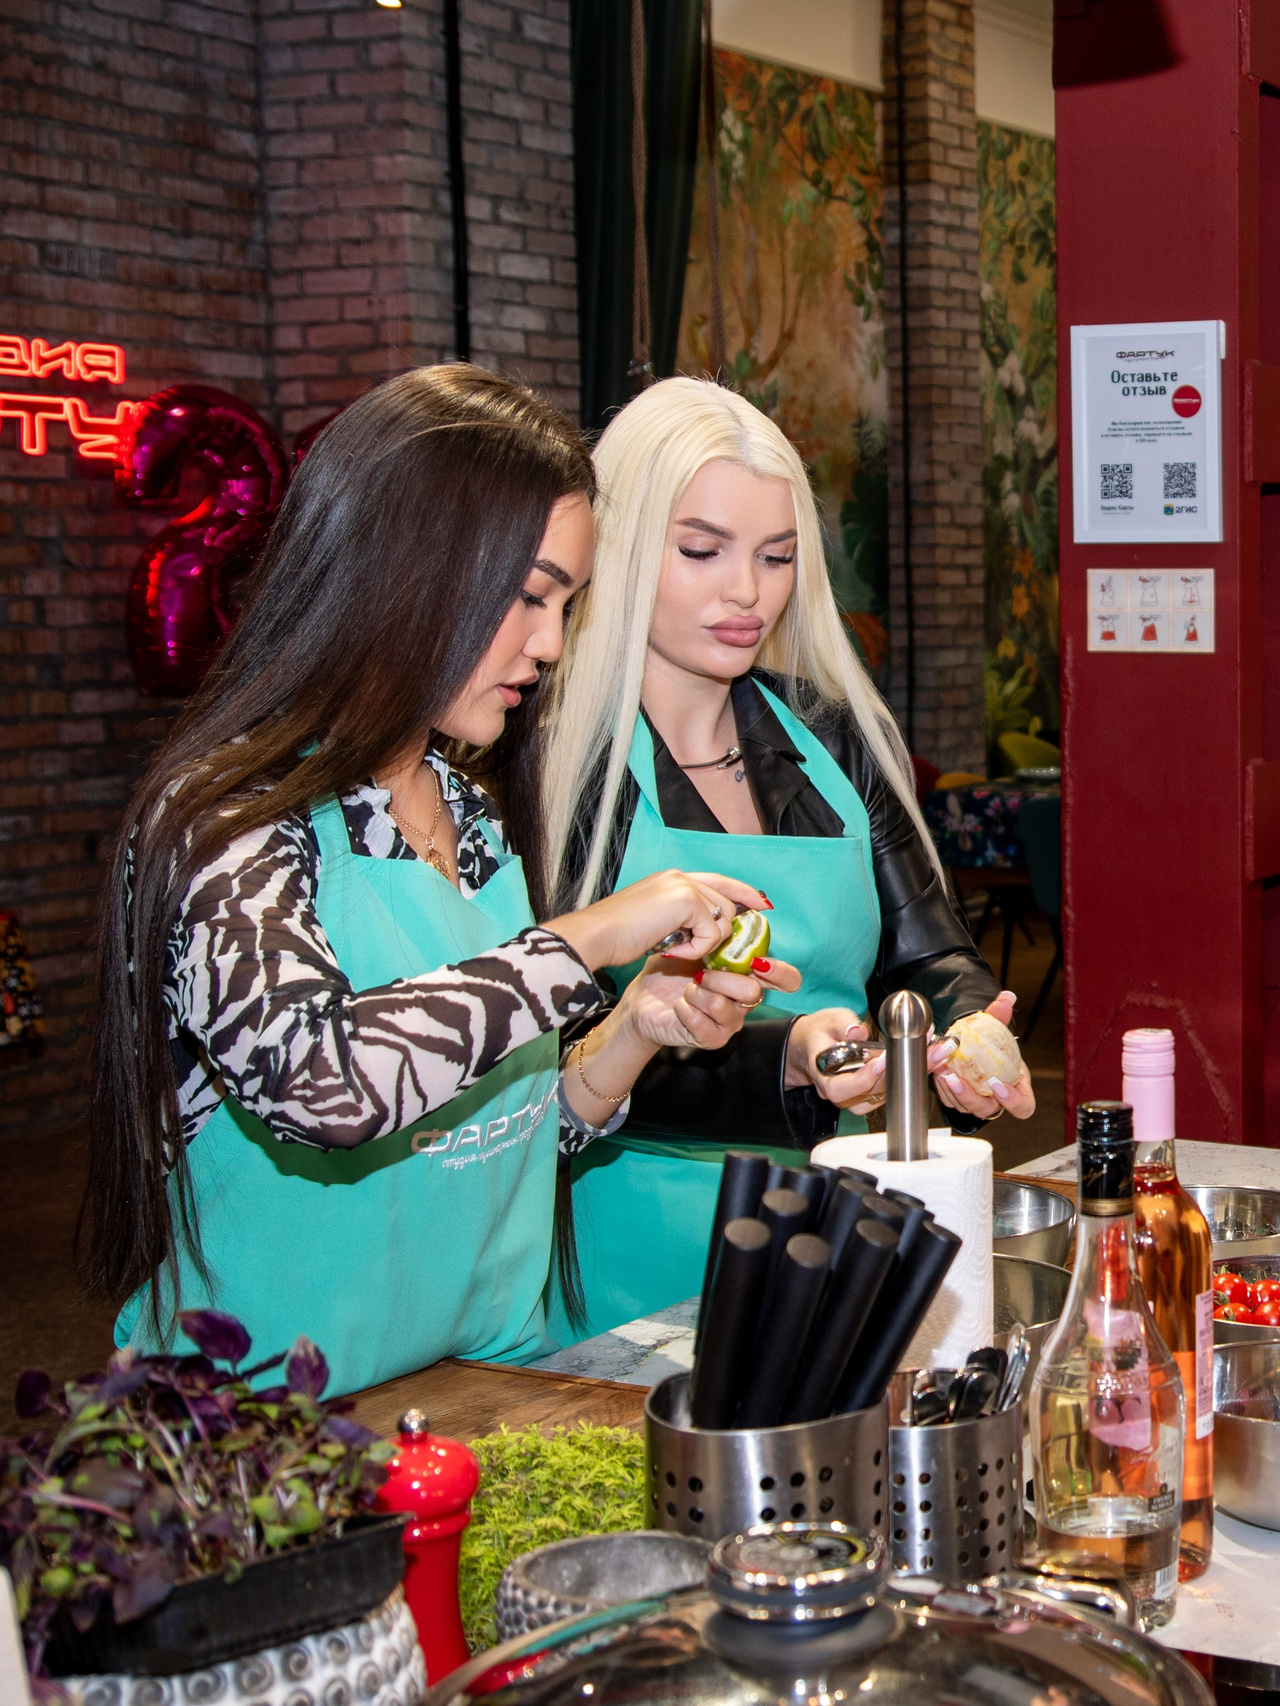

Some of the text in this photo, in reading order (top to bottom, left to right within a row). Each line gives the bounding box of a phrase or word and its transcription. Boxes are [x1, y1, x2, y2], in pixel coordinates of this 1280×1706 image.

[1116, 350, 1175, 359] ФАРТУК
[1111, 370, 1178, 383] Оставьте
[1122, 385, 1167, 397] отзыв
[1175, 505, 1198, 514] 2ГИС
[442, 1153, 477, 1170] студия
